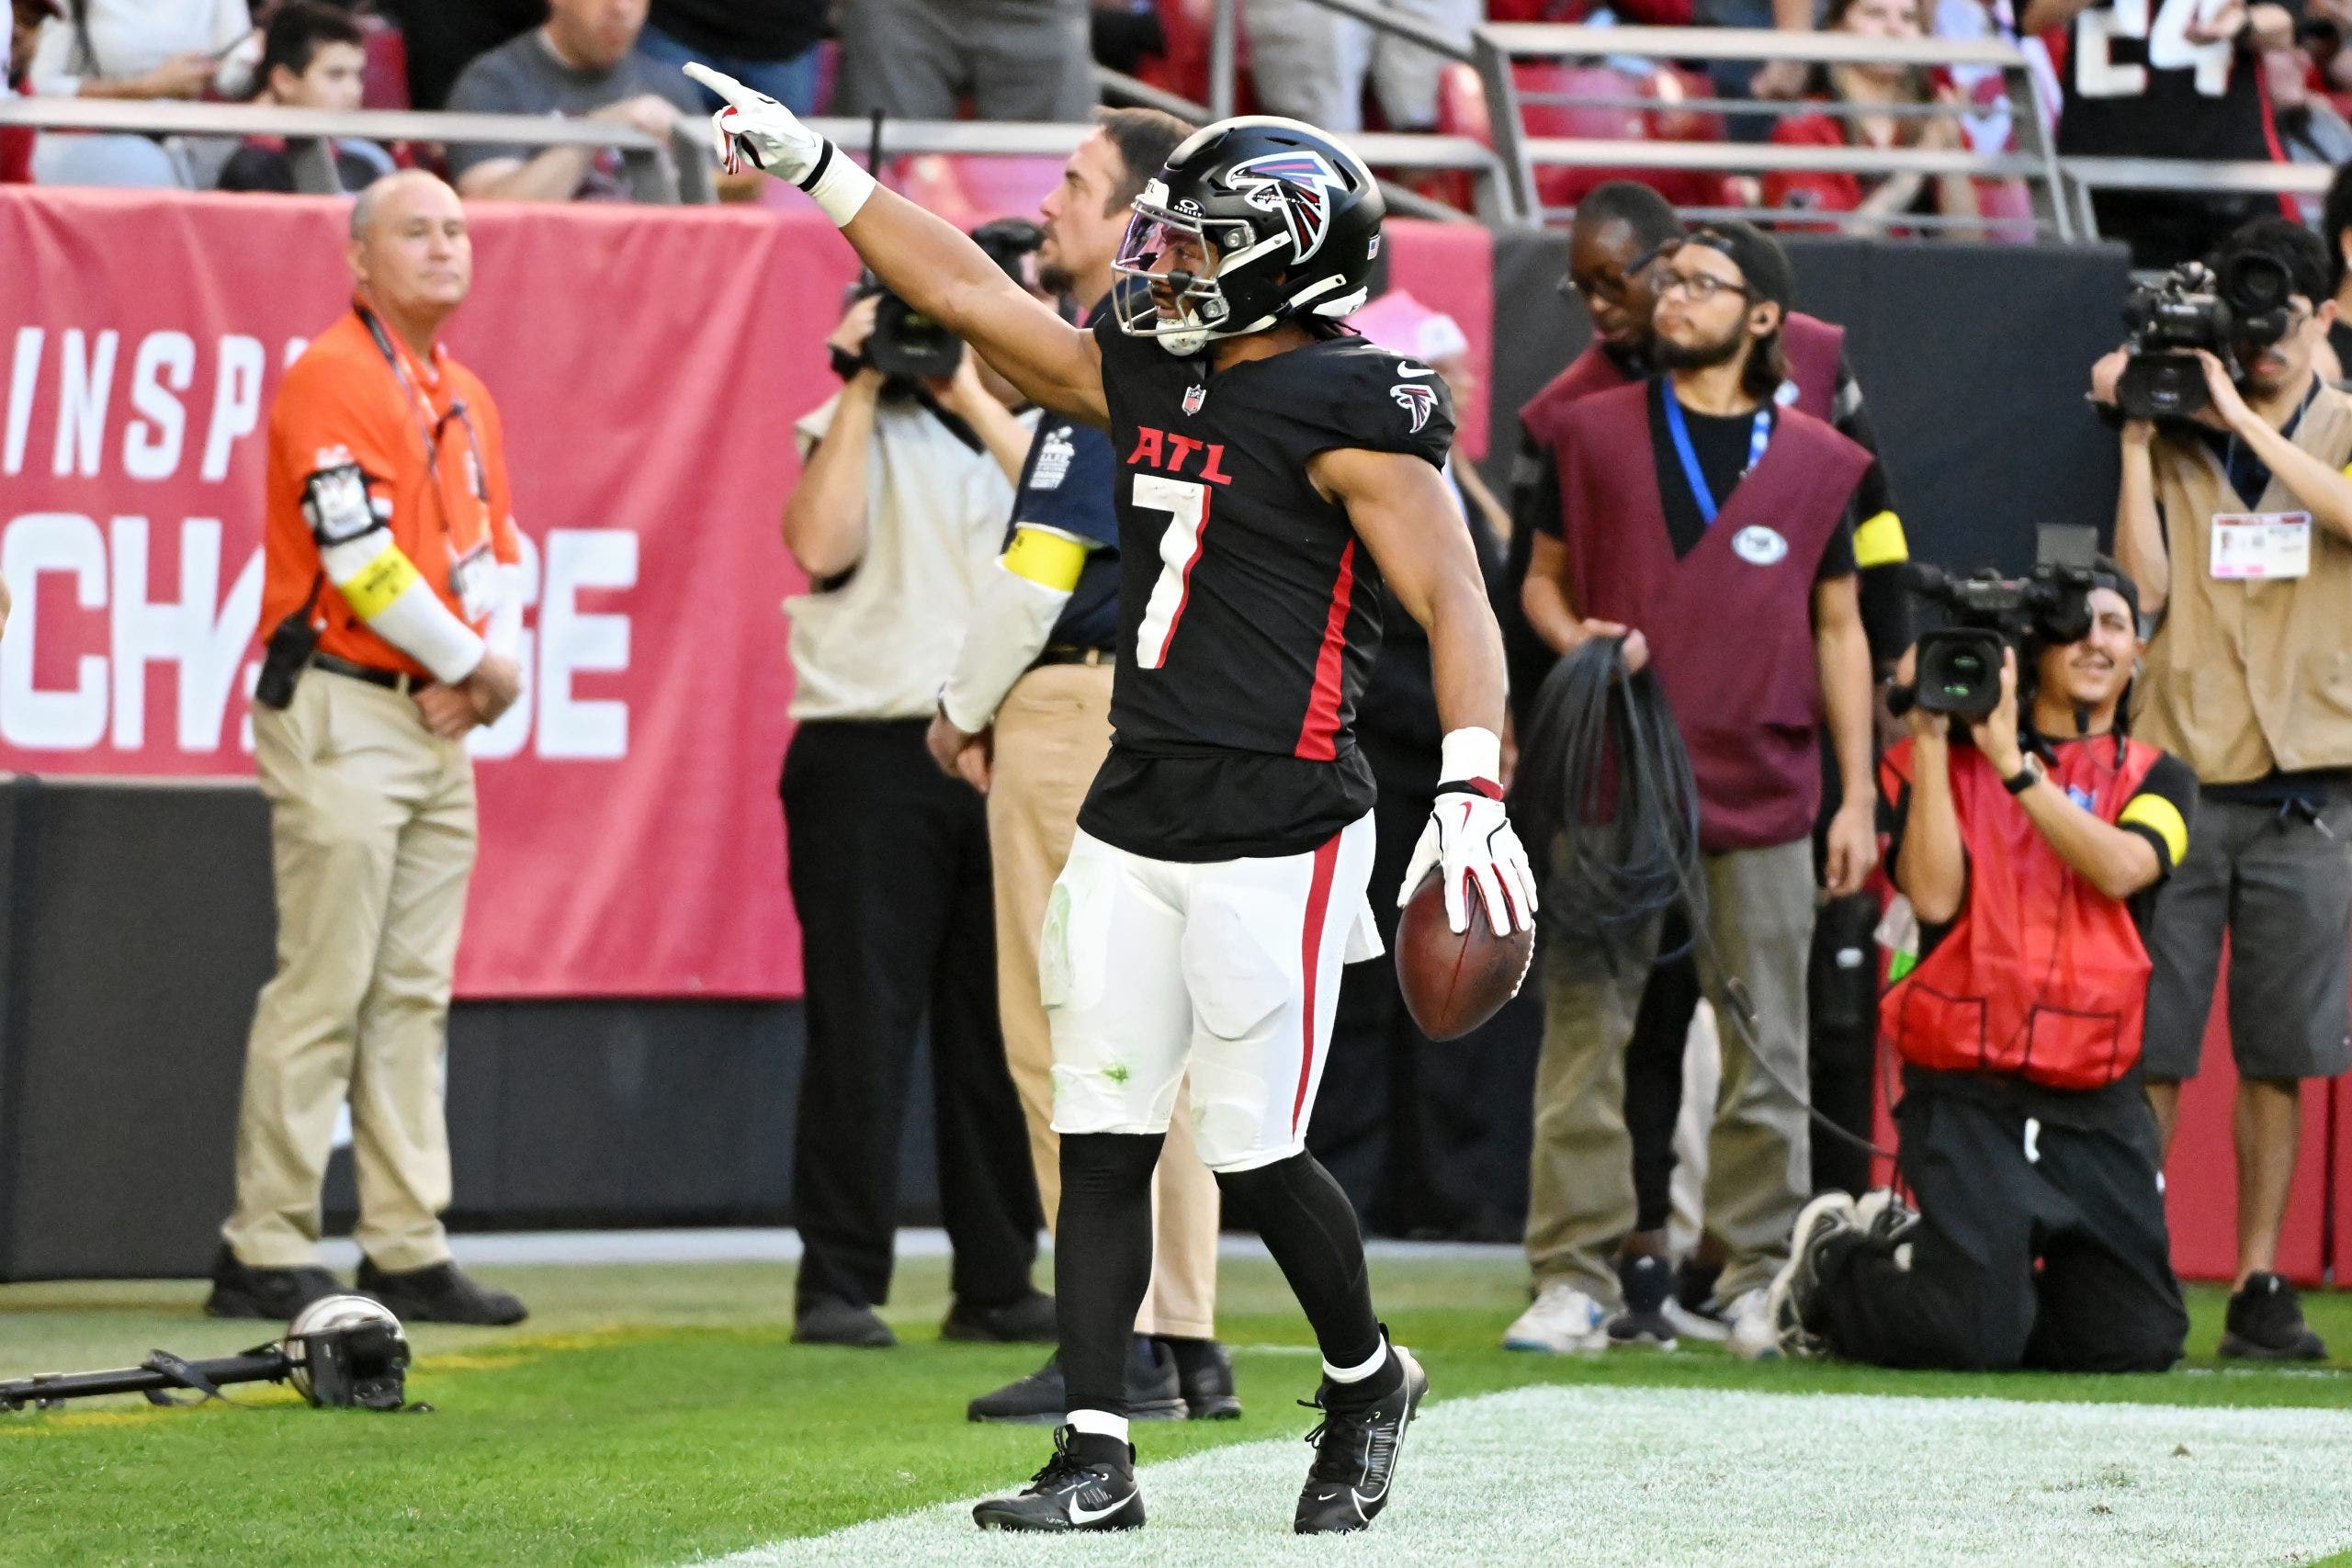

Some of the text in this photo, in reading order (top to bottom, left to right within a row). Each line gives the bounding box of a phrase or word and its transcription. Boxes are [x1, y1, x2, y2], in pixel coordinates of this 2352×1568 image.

[2075, 0, 2234, 97] 24
[4, 326, 311, 483] INSP
[1125, 425, 1233, 486] ATL
[0, 511, 639, 760] CHE
[1131, 472, 1213, 670] 7
